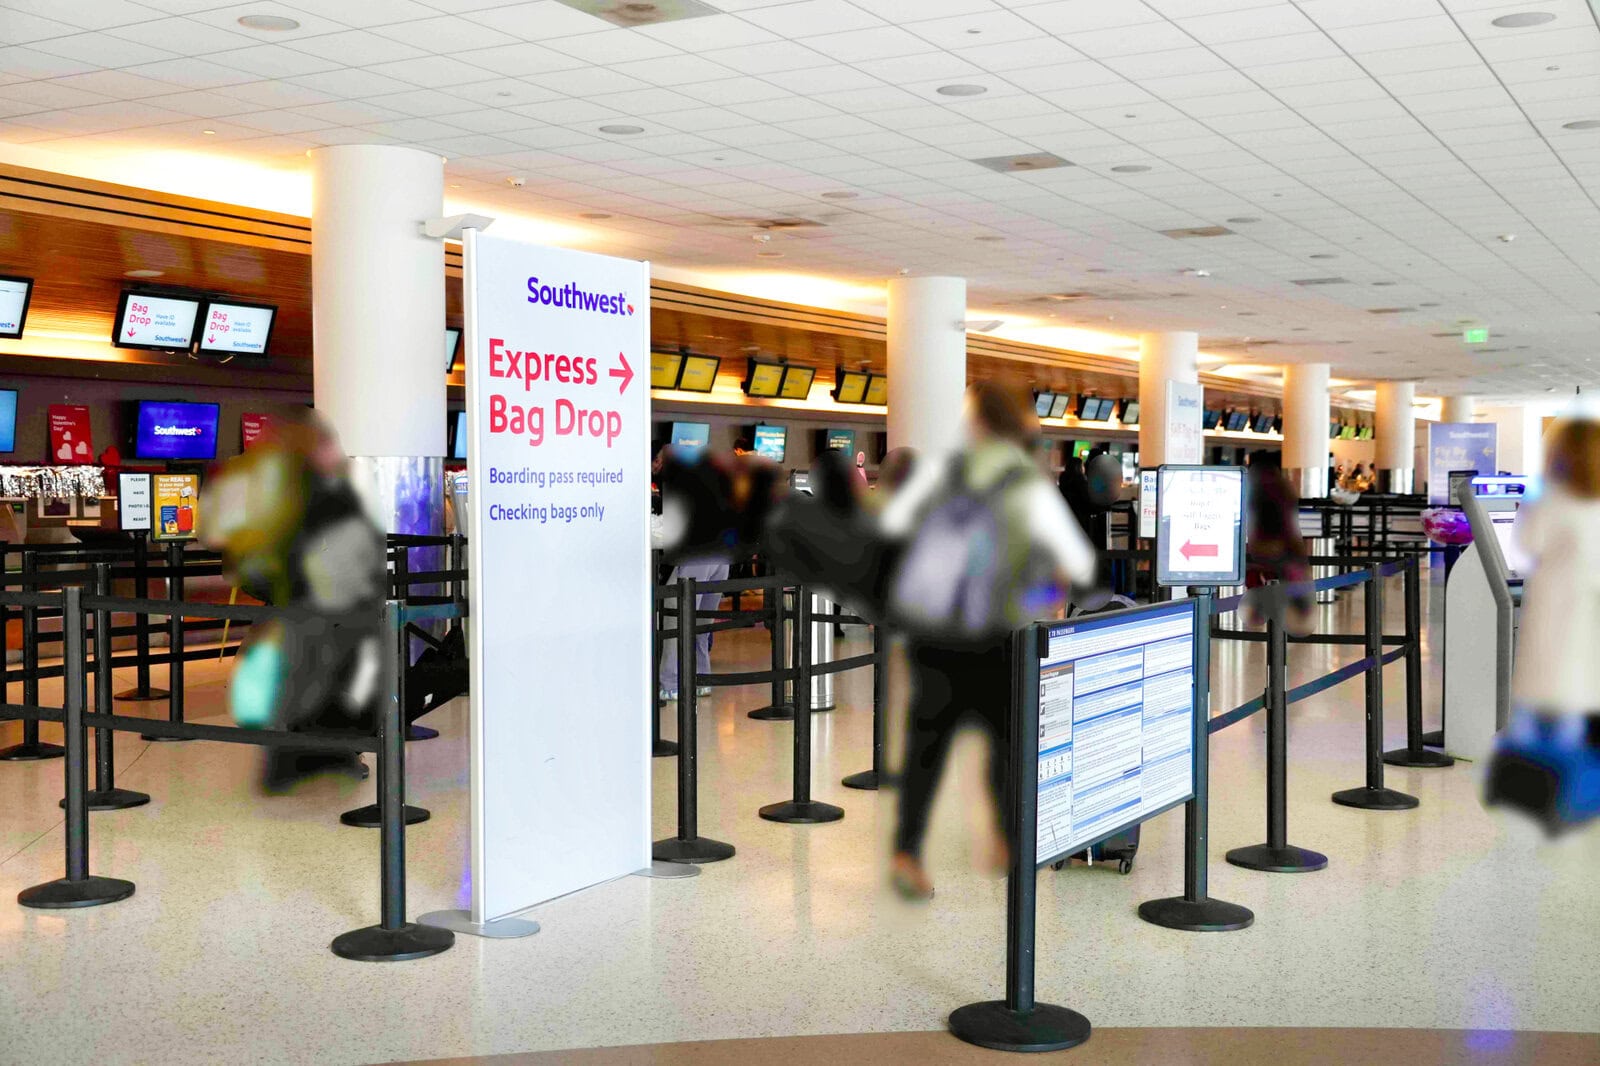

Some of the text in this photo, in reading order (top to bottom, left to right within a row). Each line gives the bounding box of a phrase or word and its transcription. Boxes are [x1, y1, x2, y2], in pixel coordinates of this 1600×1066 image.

[527, 276, 625, 316] Southwest
[132, 303, 148, 315] Bag
[129, 314, 151, 327] Drop
[212, 310, 228, 322] Bag
[210, 321, 230, 333] Drop
[155, 334, 183, 343] Southwest
[489, 338, 598, 392] Express
[489, 394, 622, 448] Bag Drop
[154, 425, 196, 436] Southwest
[489, 467, 623, 488] Boarding pass required
[489, 502, 605, 524] Checking bags only
